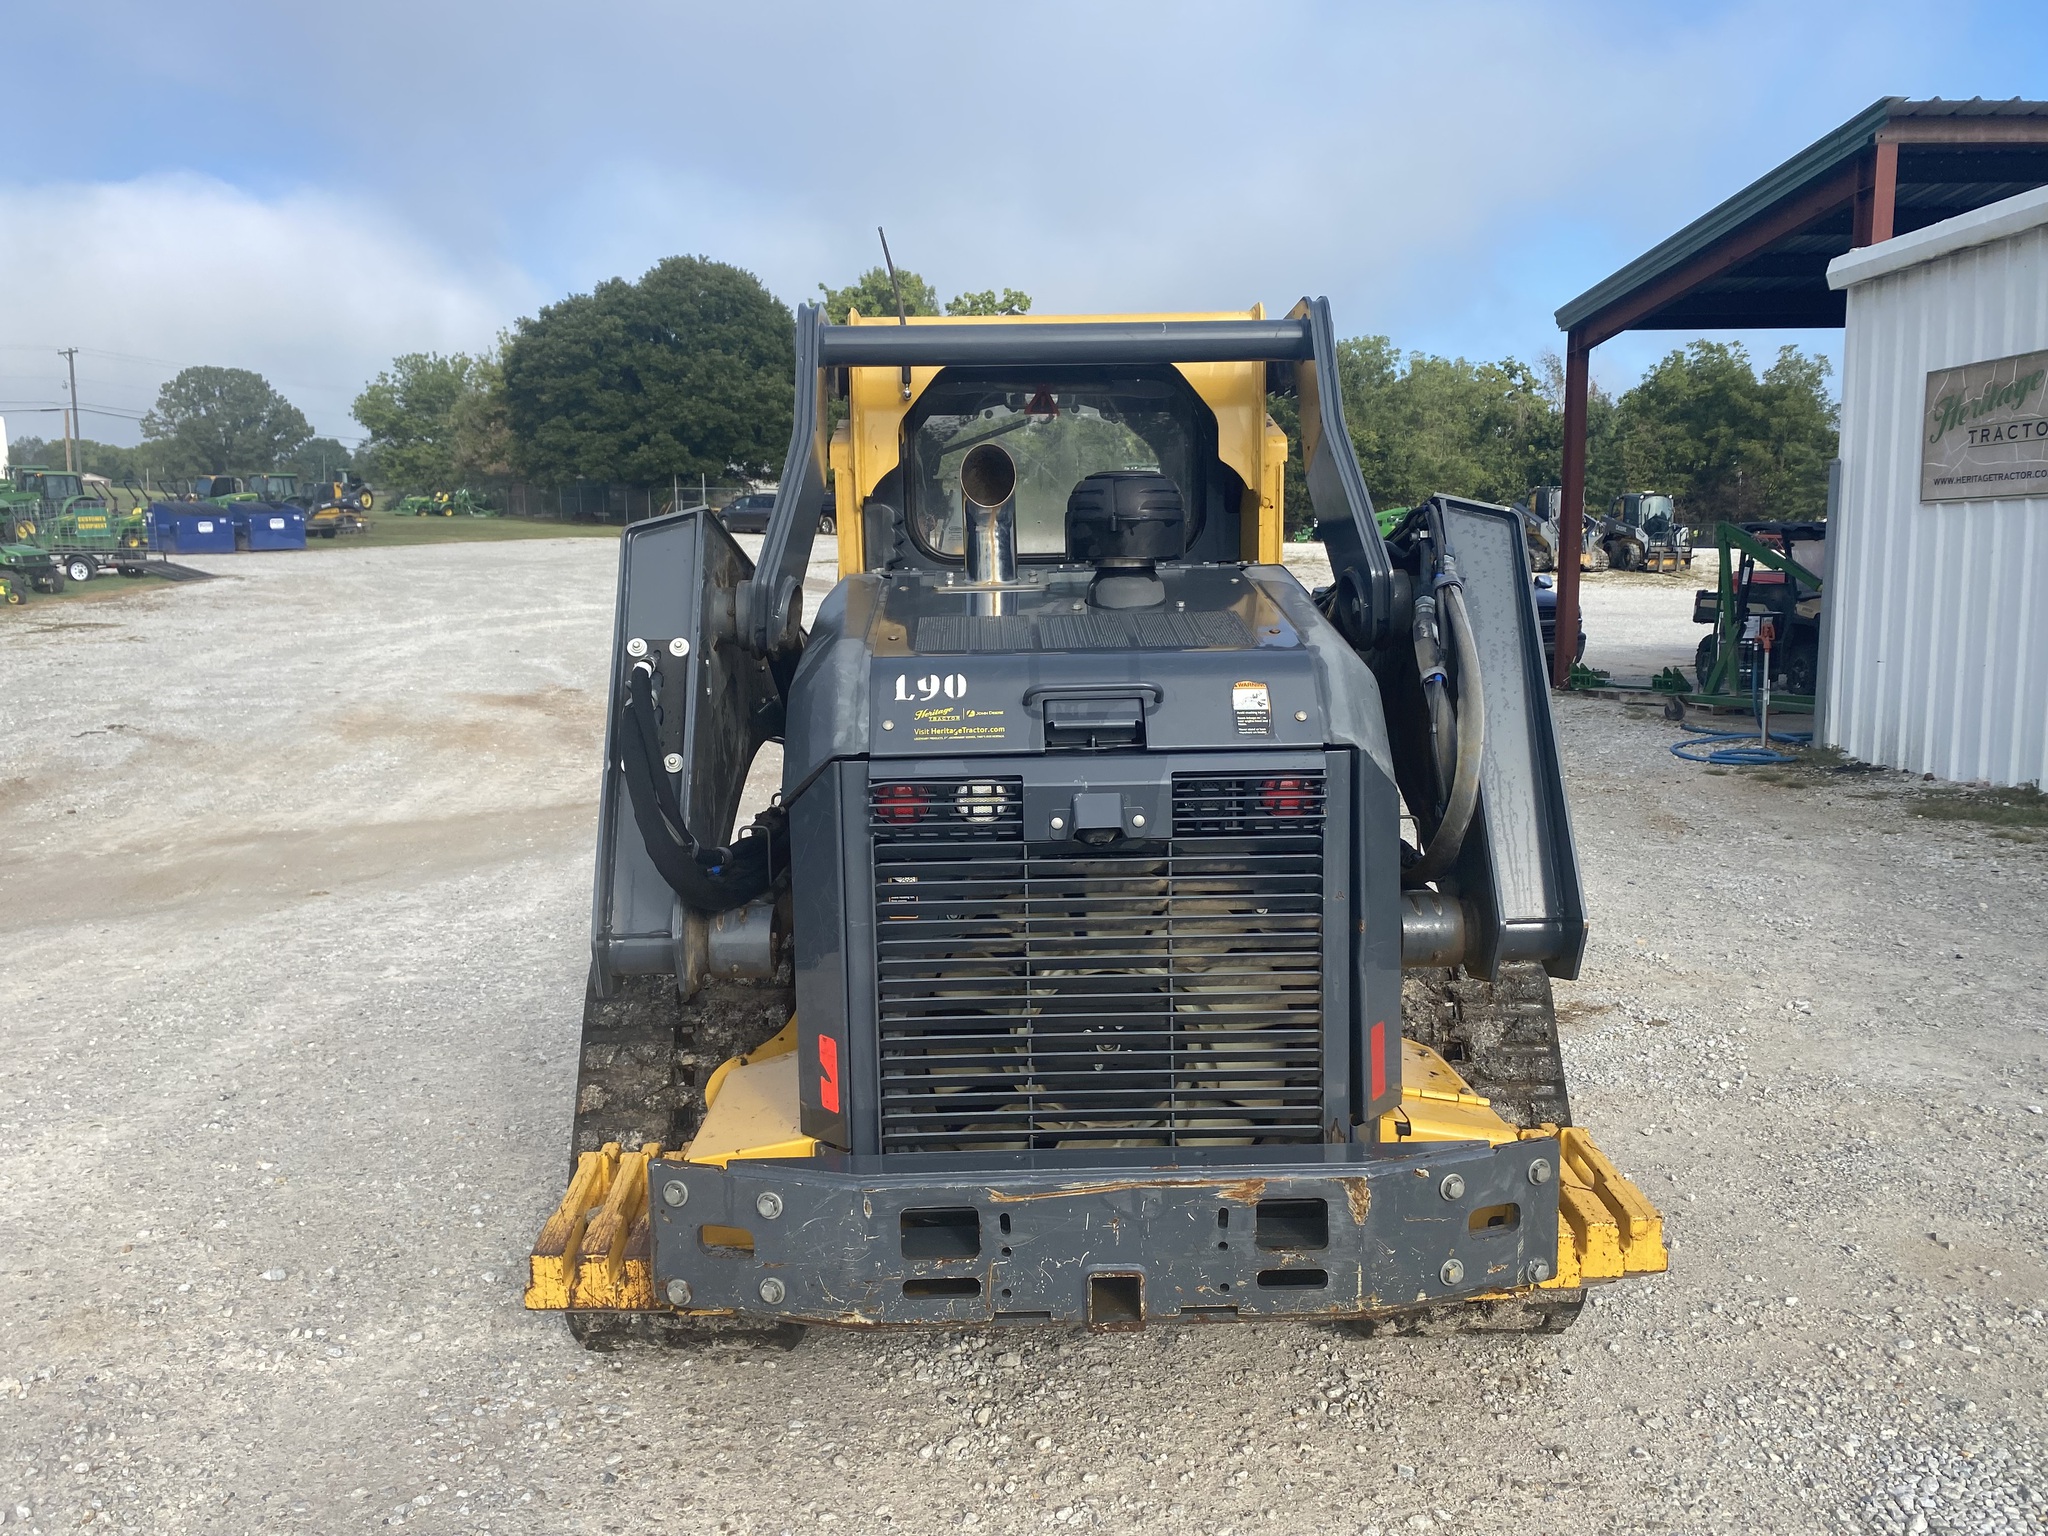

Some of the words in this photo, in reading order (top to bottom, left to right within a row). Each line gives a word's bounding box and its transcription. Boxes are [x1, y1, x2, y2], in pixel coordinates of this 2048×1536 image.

[1929, 369, 2045, 444] Heritage
[1968, 421, 2048, 444] TRACTO
[1933, 469, 2048, 486] WWW.HERITAGETRACTOR.CO
[914, 707, 954, 720] Heritage
[931, 727, 1006, 736] HeritageTractor.com
